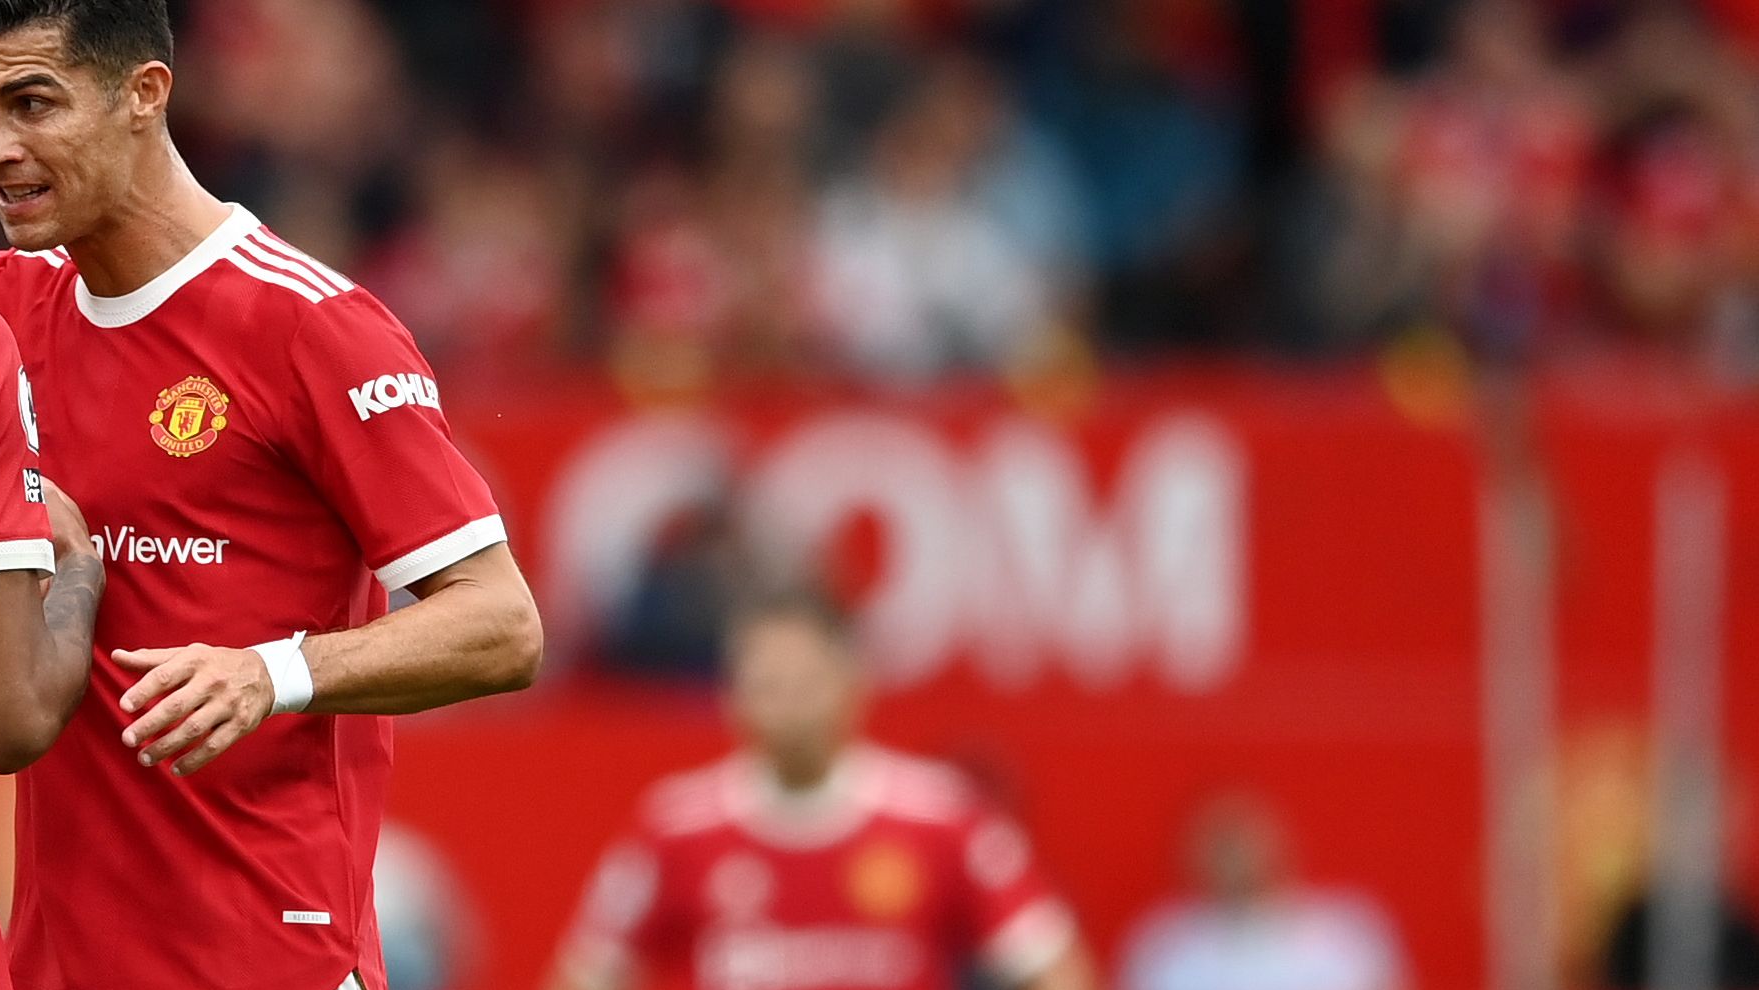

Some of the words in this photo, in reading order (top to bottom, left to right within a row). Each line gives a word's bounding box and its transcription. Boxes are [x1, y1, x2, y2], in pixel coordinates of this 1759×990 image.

[160, 381, 224, 411] MANCHESTER
[347, 372, 441, 422] KOHLE
[159, 434, 205, 452] UNITED
